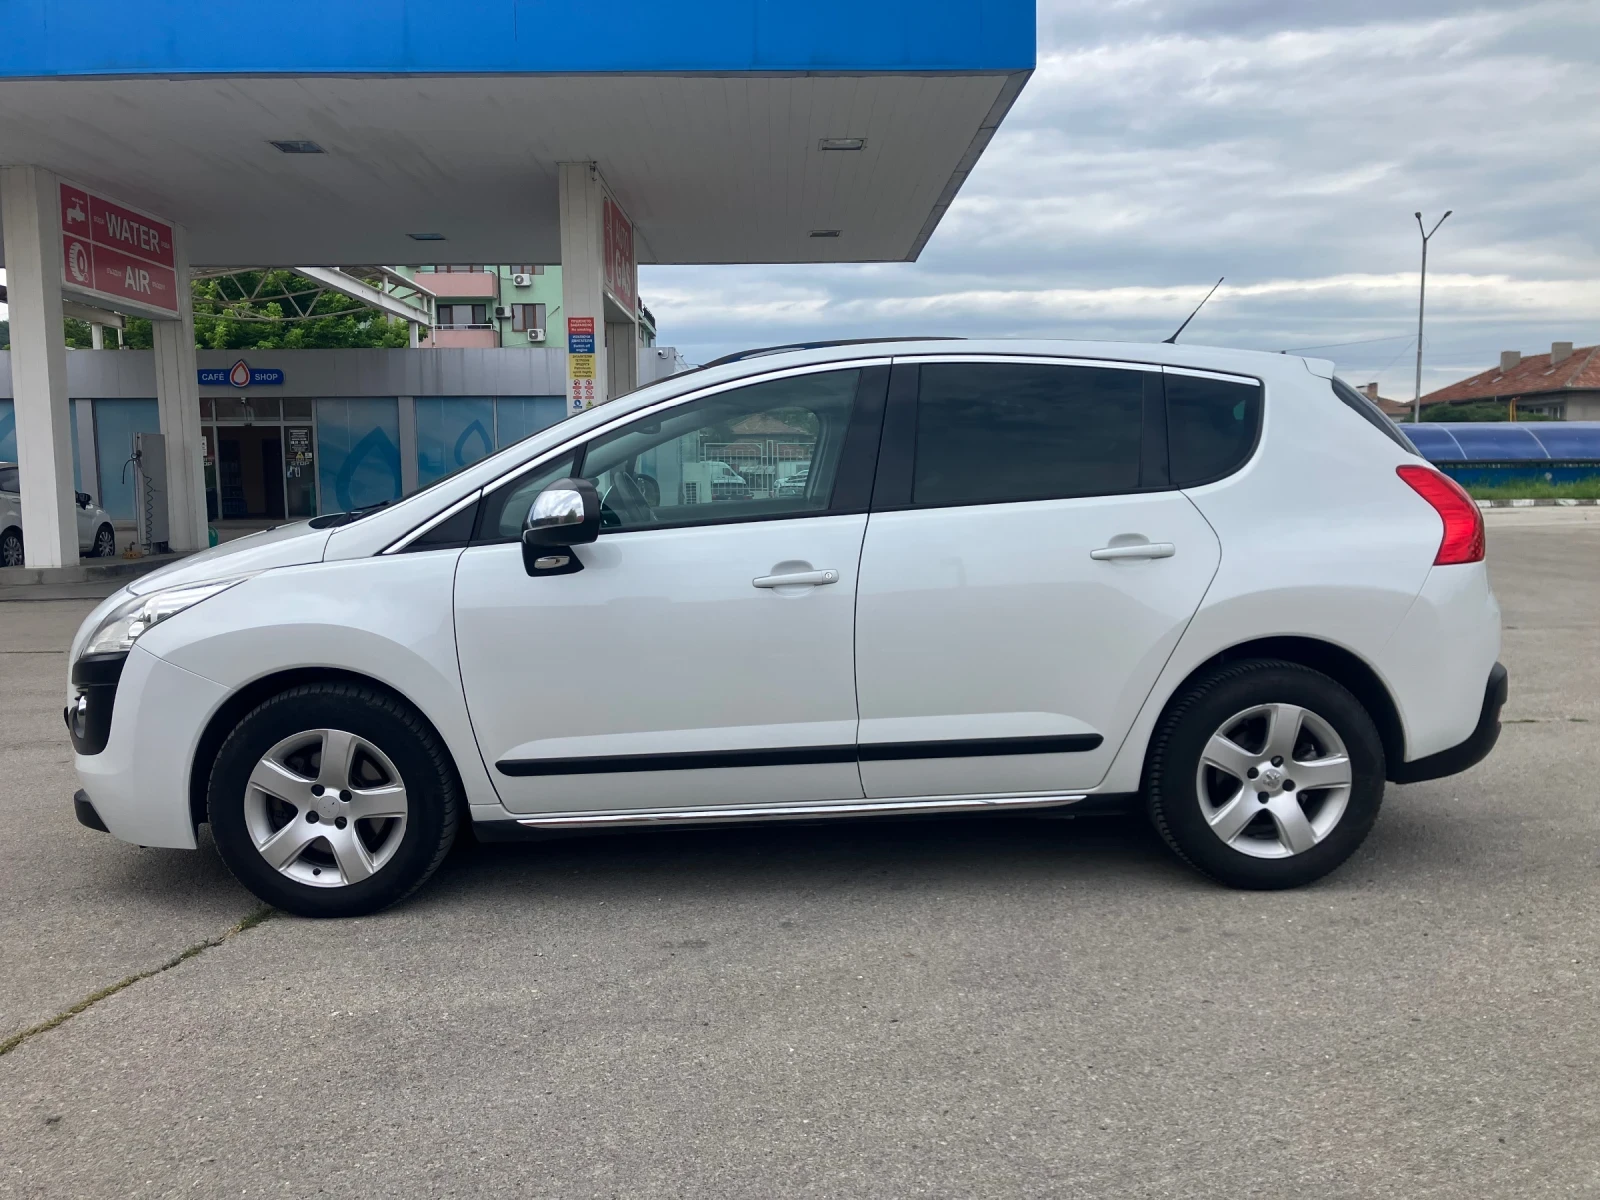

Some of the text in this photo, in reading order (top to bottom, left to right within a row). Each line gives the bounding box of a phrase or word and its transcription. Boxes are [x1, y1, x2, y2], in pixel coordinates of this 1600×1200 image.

[105, 211, 160, 254] WATER
[124, 265, 151, 295] AIR
[615, 249, 631, 298] GAS
[201, 371, 225, 381] CAFÉ
[254, 373, 278, 381] SHOP
